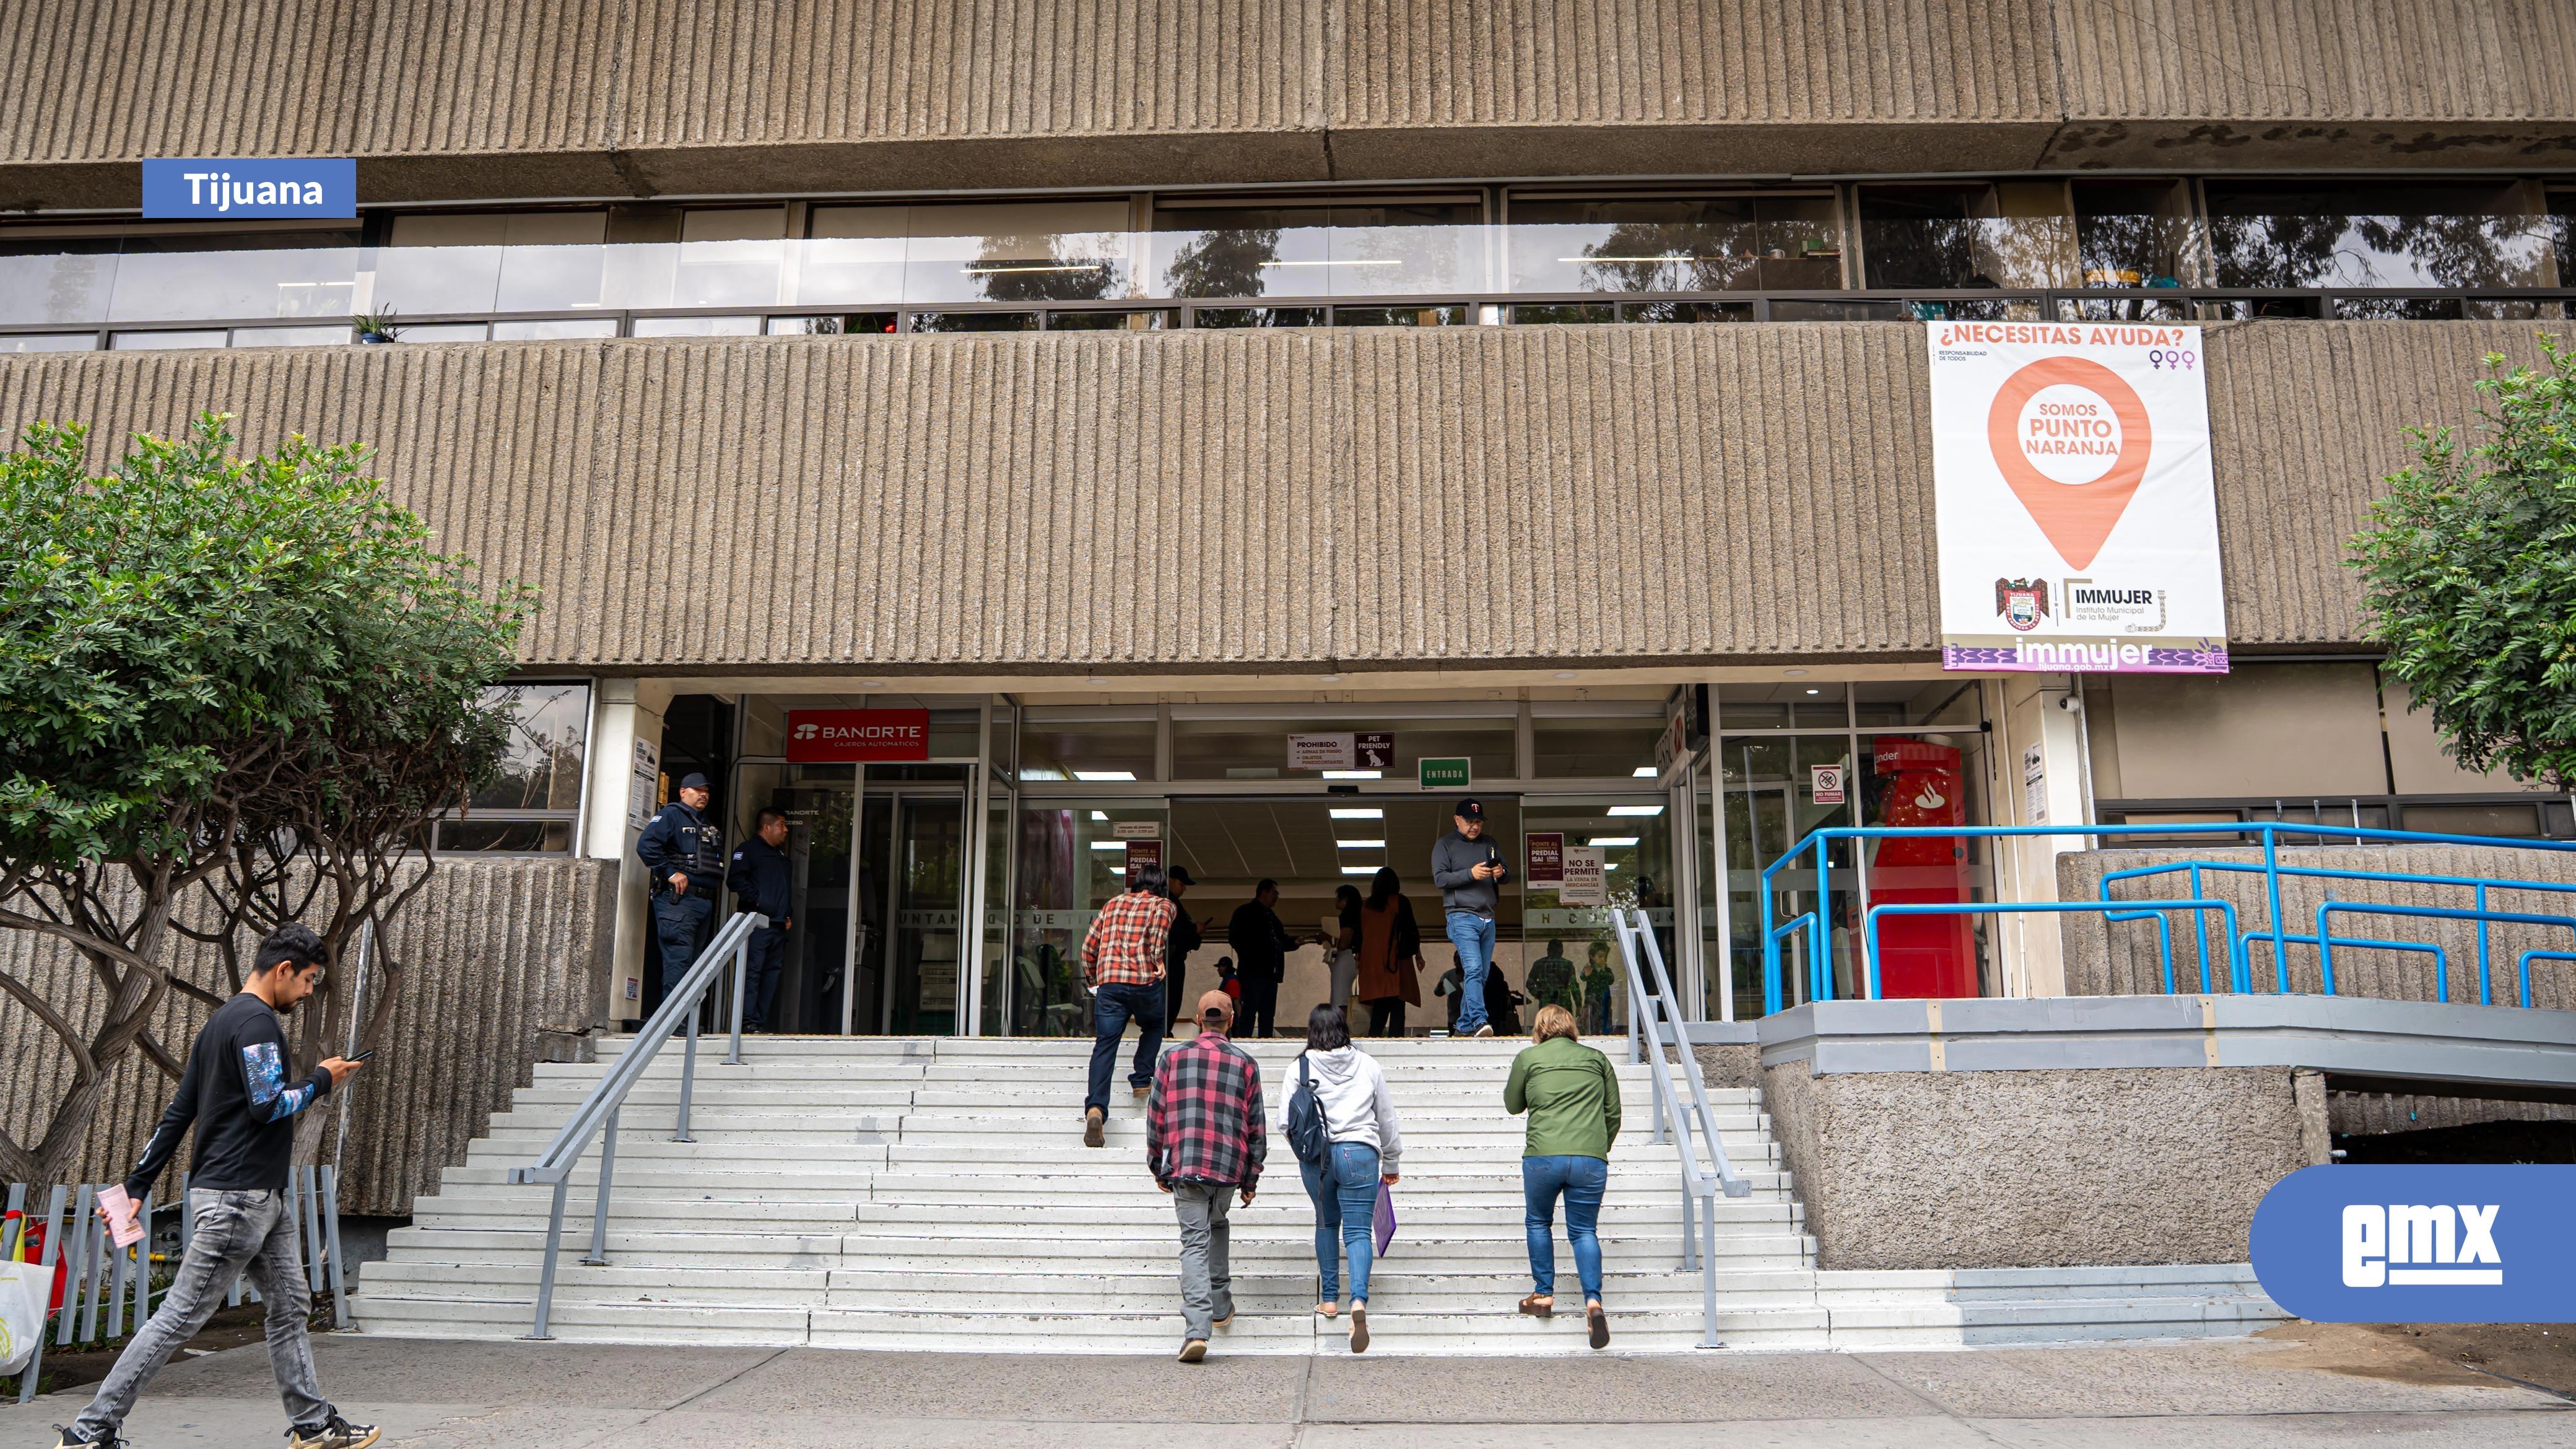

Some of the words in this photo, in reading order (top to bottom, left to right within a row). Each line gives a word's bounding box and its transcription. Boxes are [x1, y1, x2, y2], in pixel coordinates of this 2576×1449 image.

[1940, 324, 2081, 346] ¿NECESITAS
[2089, 327, 2184, 347] AYUDA?
[2039, 403, 2097, 417] SOMOS
[2030, 418, 2112, 438] PUNTO
[2026, 440, 2119, 455] NARANJA
[2076, 589, 2152, 604] IMMUJER
[2097, 614, 2120, 622] Mujer
[2107, 607, 2144, 616] Municipal
[2016, 637, 2153, 671] immujer
[822, 726, 921, 738] BANORTE
[1427, 770, 1463, 778] ENTRADA
